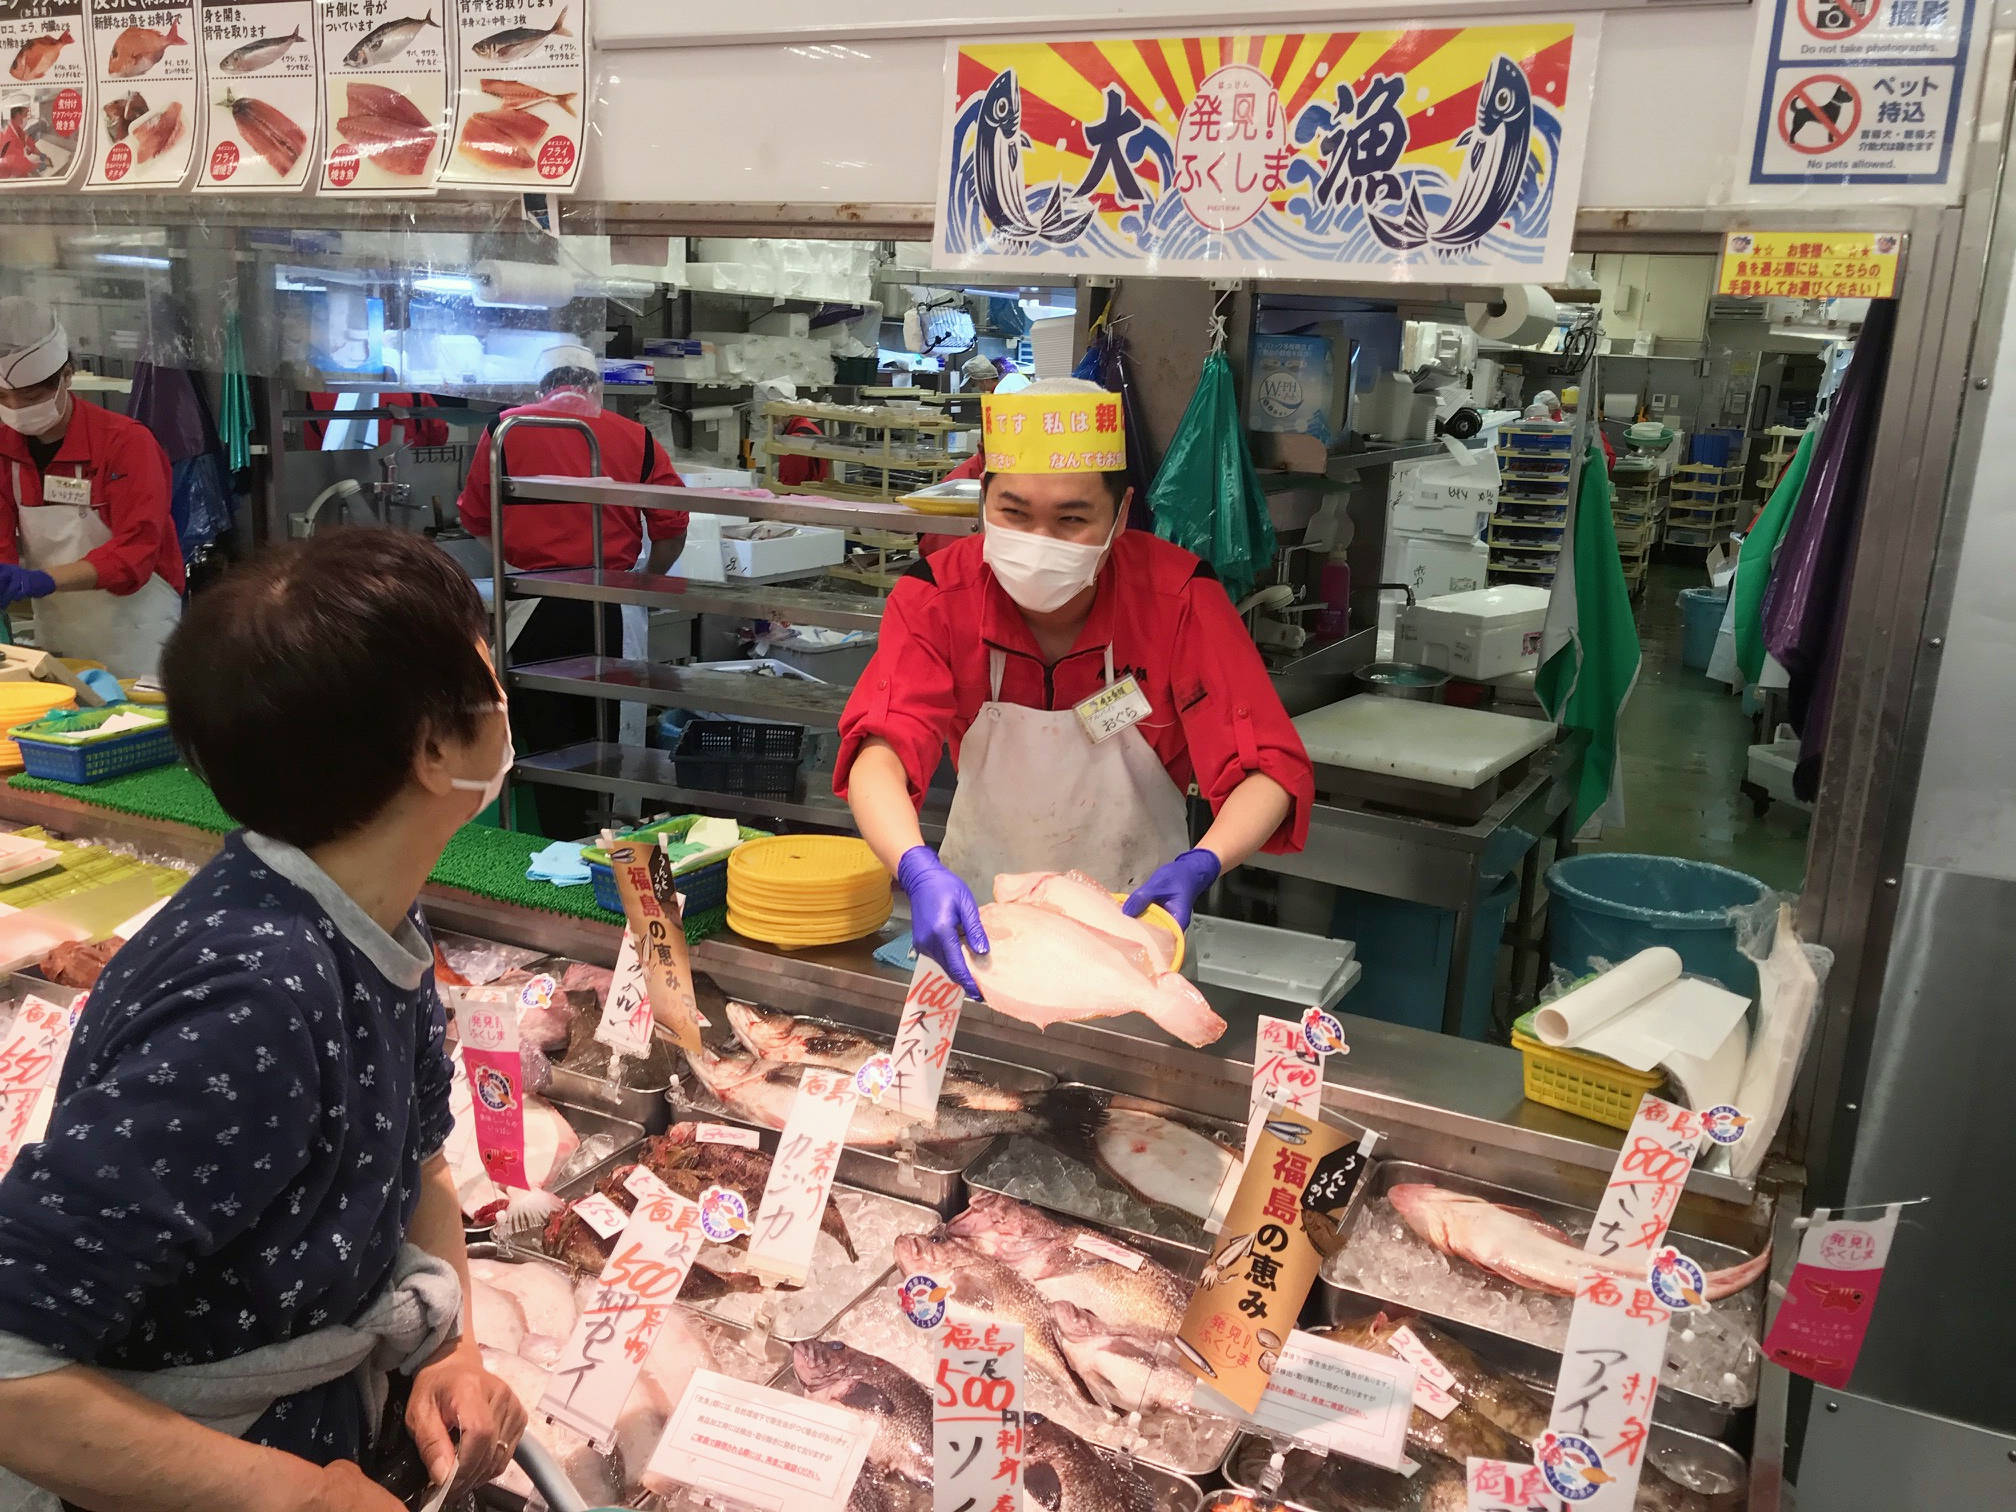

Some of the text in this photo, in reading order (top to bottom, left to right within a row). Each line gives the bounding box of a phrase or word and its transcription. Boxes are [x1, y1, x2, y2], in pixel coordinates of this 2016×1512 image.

[204, 25, 266, 40] 背骨を取ります
[326, 20, 374, 32] ついています
[1801, 44, 1816, 54] Do
[1819, 44, 1837, 54] not
[1840, 44, 1862, 54] take
[1873, 76, 1938, 97] ペット
[1190, 91, 1278, 142] 発見!
[1878, 101, 1925, 123] 持込
[216, 152, 235, 162] フライ
[547, 147, 568, 156] フライ
[1075, 76, 1408, 208] 大 漁
[541, 157, 571, 165] ムニエル
[1173, 148, 1289, 193] ふくしま
[1807, 159, 1896, 171] No pets allowed.
[627, 866, 681, 991] 福島の恵み
[892, 1010, 930, 1113] スズキ
[1238, 1147, 1312, 1320] 福島の恵み
[600, 1242, 682, 1299] 500
[1577, 1272, 1671, 1326] 福島
[940, 1316, 1016, 1357] 福島
[936, 1358, 1016, 1412] 500
[1001, 1408, 1021, 1428] 円
